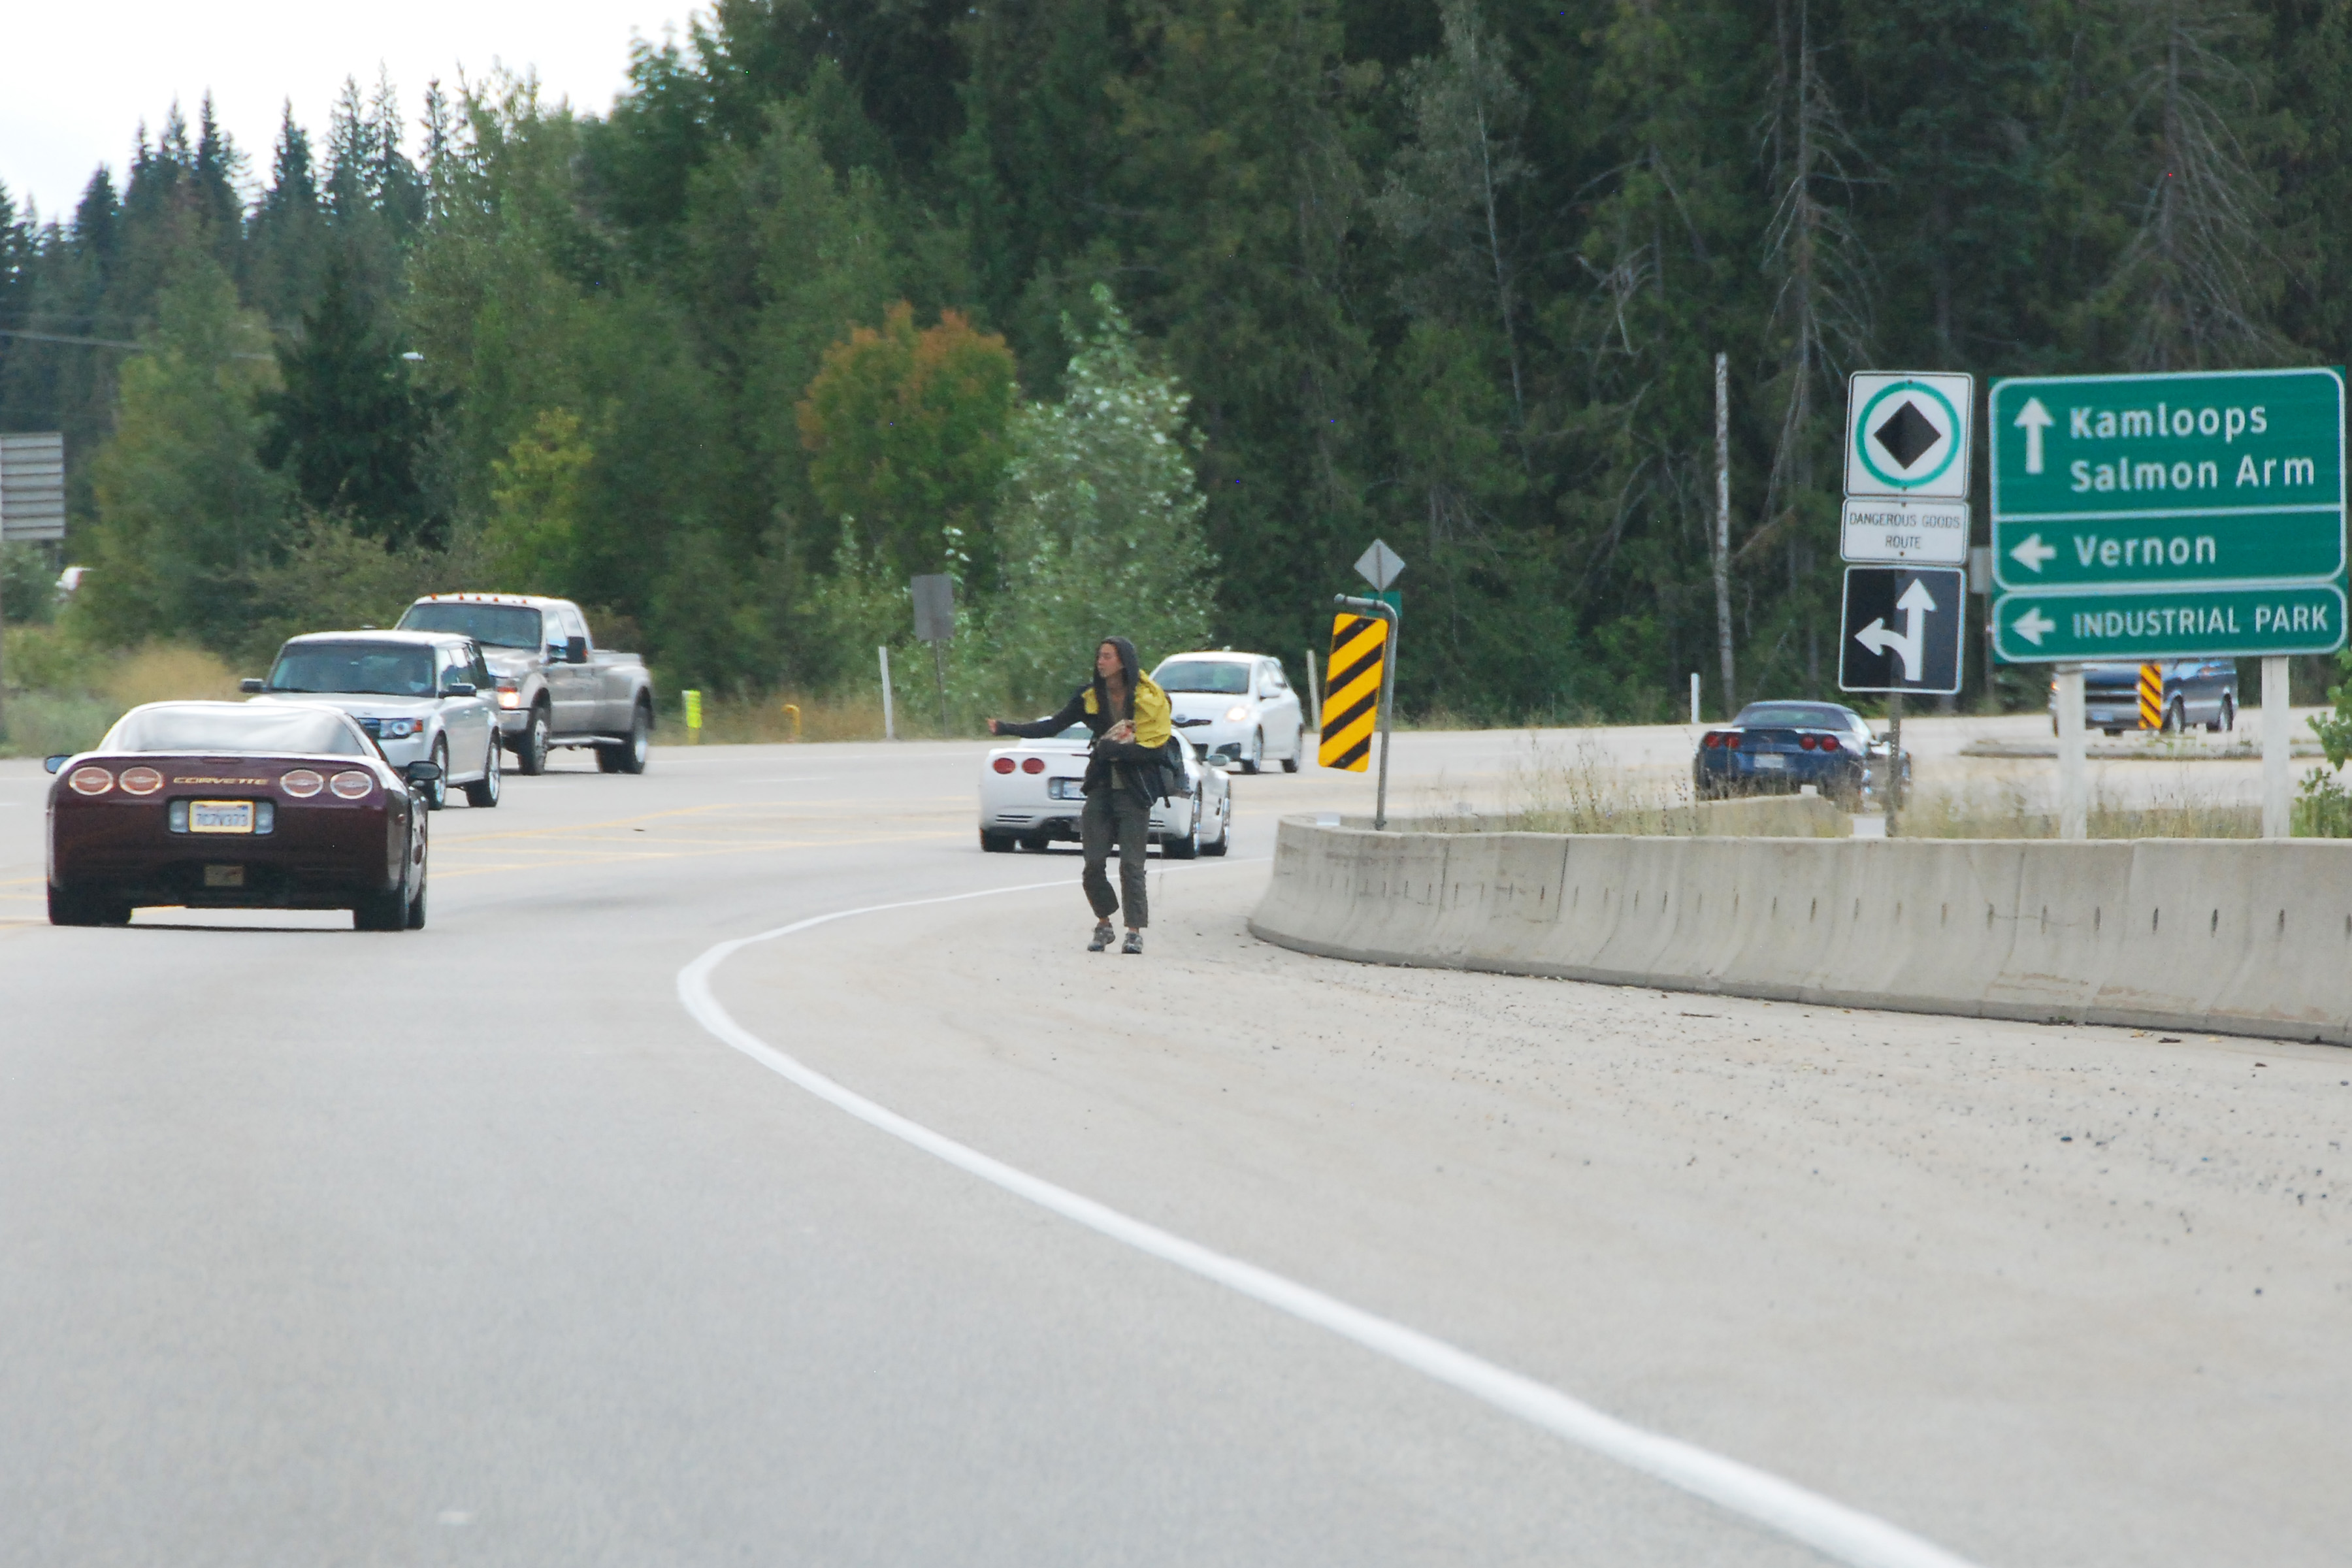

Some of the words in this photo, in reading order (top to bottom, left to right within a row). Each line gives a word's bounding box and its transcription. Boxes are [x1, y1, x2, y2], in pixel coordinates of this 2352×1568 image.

[2070, 402, 2268, 444] Kamloops
[2070, 457, 2218, 493] Salmon
[2235, 455, 2315, 487] Arm
[1849, 512, 1917, 527] DANGEROUS
[1921, 515, 1960, 529] GOODS
[1885, 535, 1921, 549] ROUTE
[2073, 534, 2216, 567] Vernon
[2072, 606, 2240, 639] INDUSTRIAL
[2255, 604, 2328, 633] PARK
